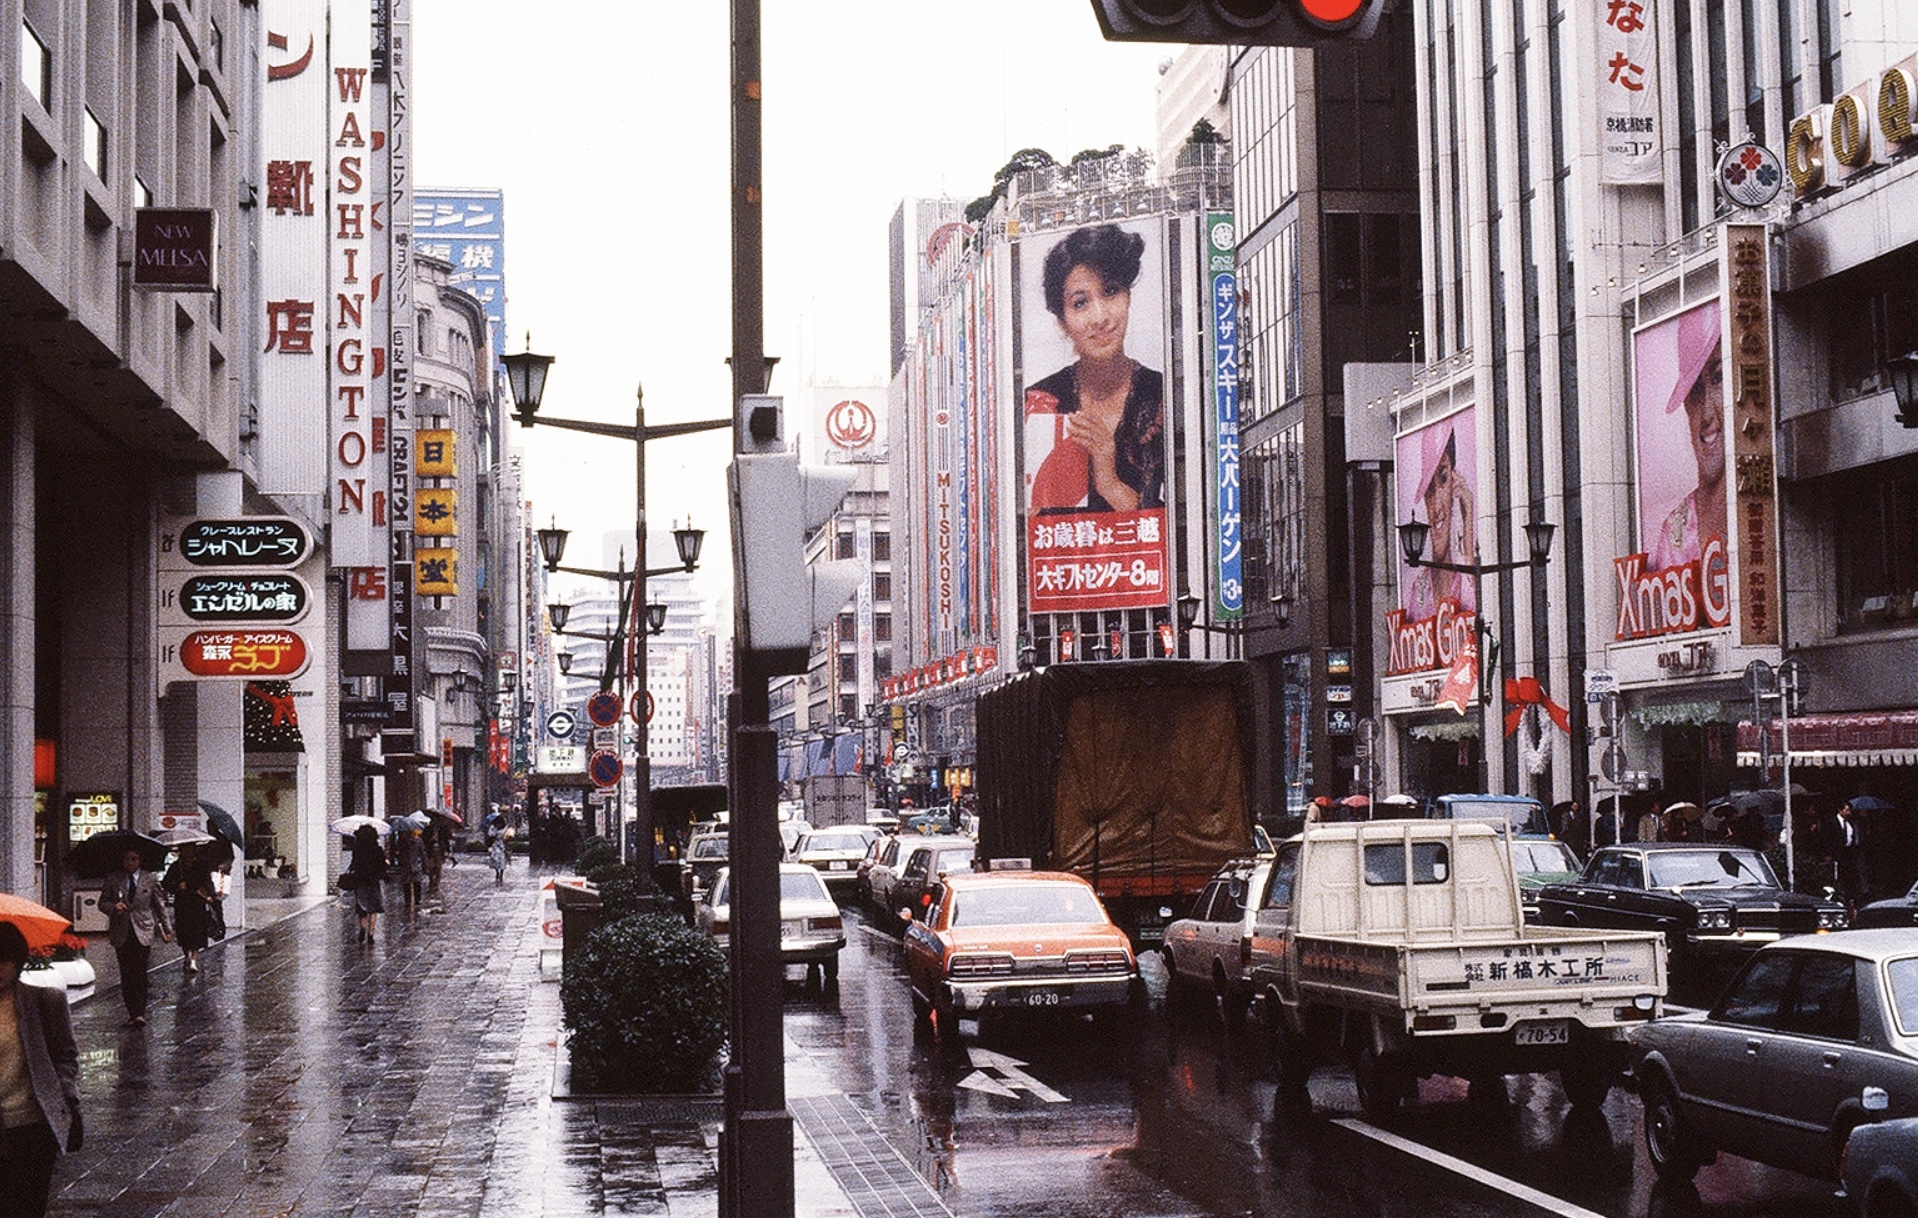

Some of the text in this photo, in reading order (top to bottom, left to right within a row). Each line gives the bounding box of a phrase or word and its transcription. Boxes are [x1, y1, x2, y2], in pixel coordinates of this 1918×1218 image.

[155, 224, 192, 239] NEW
[334, 67, 367, 514] WASHINGTON
[418, 441, 451, 585] 日本堂
[1033, 516, 1160, 549] お歳暮は三越
[936, 472, 952, 630] MITSUKOSHI
[190, 592, 297, 612] エンゼルの家
[1615, 556, 1697, 639] X'mas
[228, 645, 292, 672] ラブ
[1386, 613, 1436, 673] X'mas
